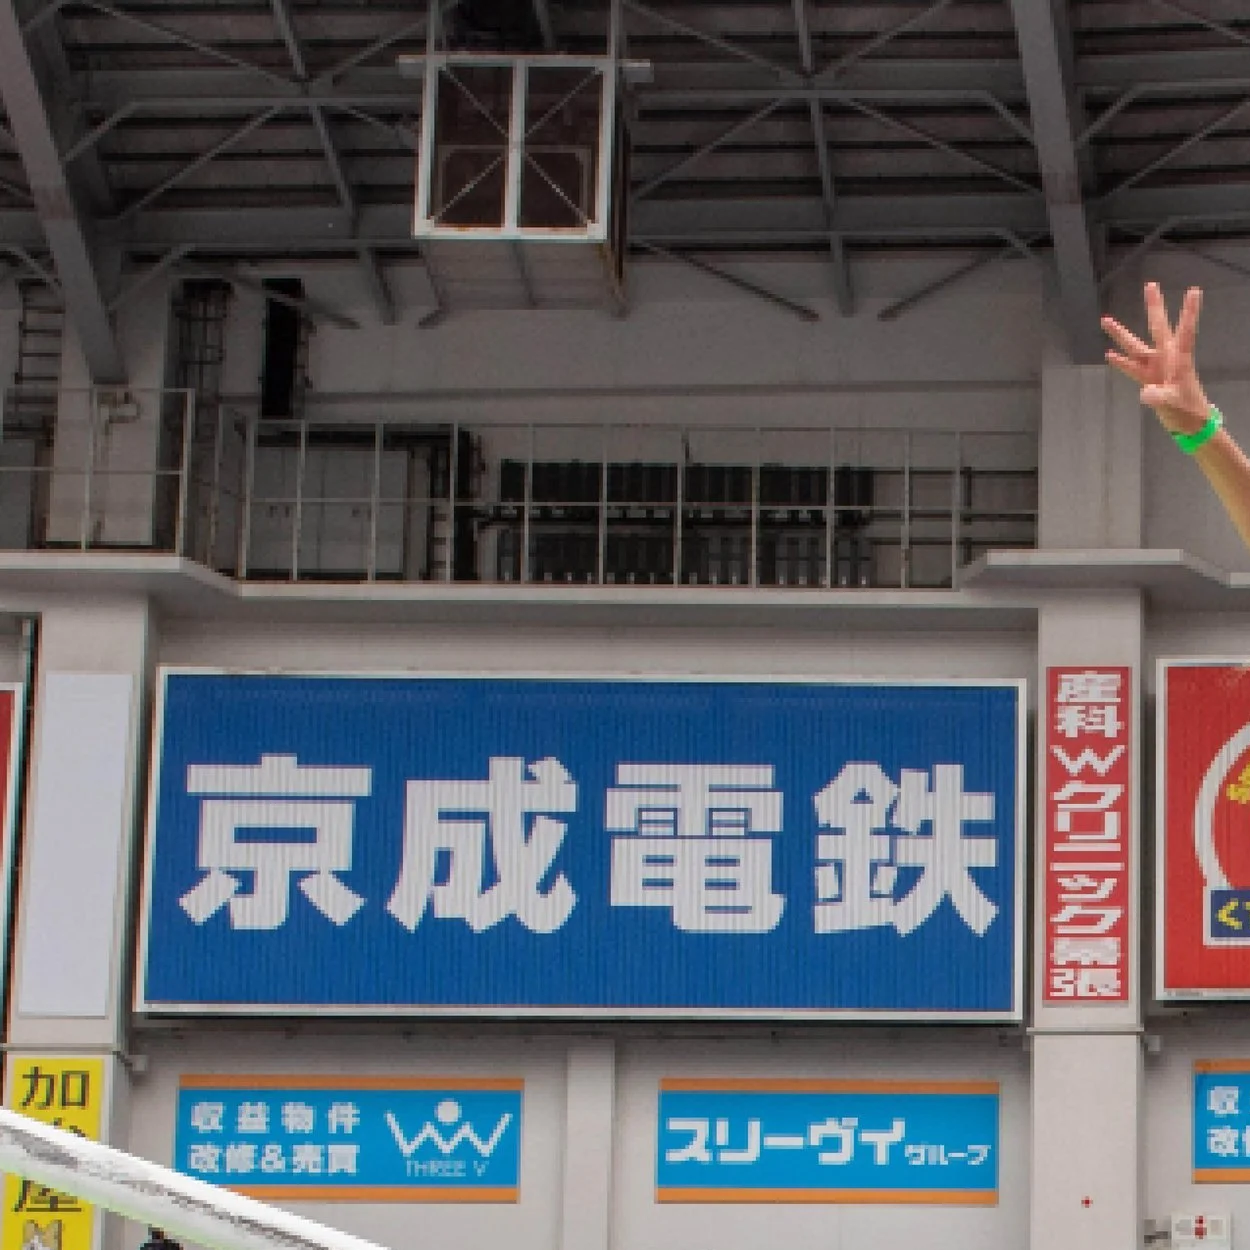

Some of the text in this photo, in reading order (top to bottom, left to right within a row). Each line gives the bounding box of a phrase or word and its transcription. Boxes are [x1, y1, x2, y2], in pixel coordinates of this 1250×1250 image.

[179, 753, 998, 938] 京成電鉄
[1051, 671, 1124, 997] 産科Wクリニック幕張
